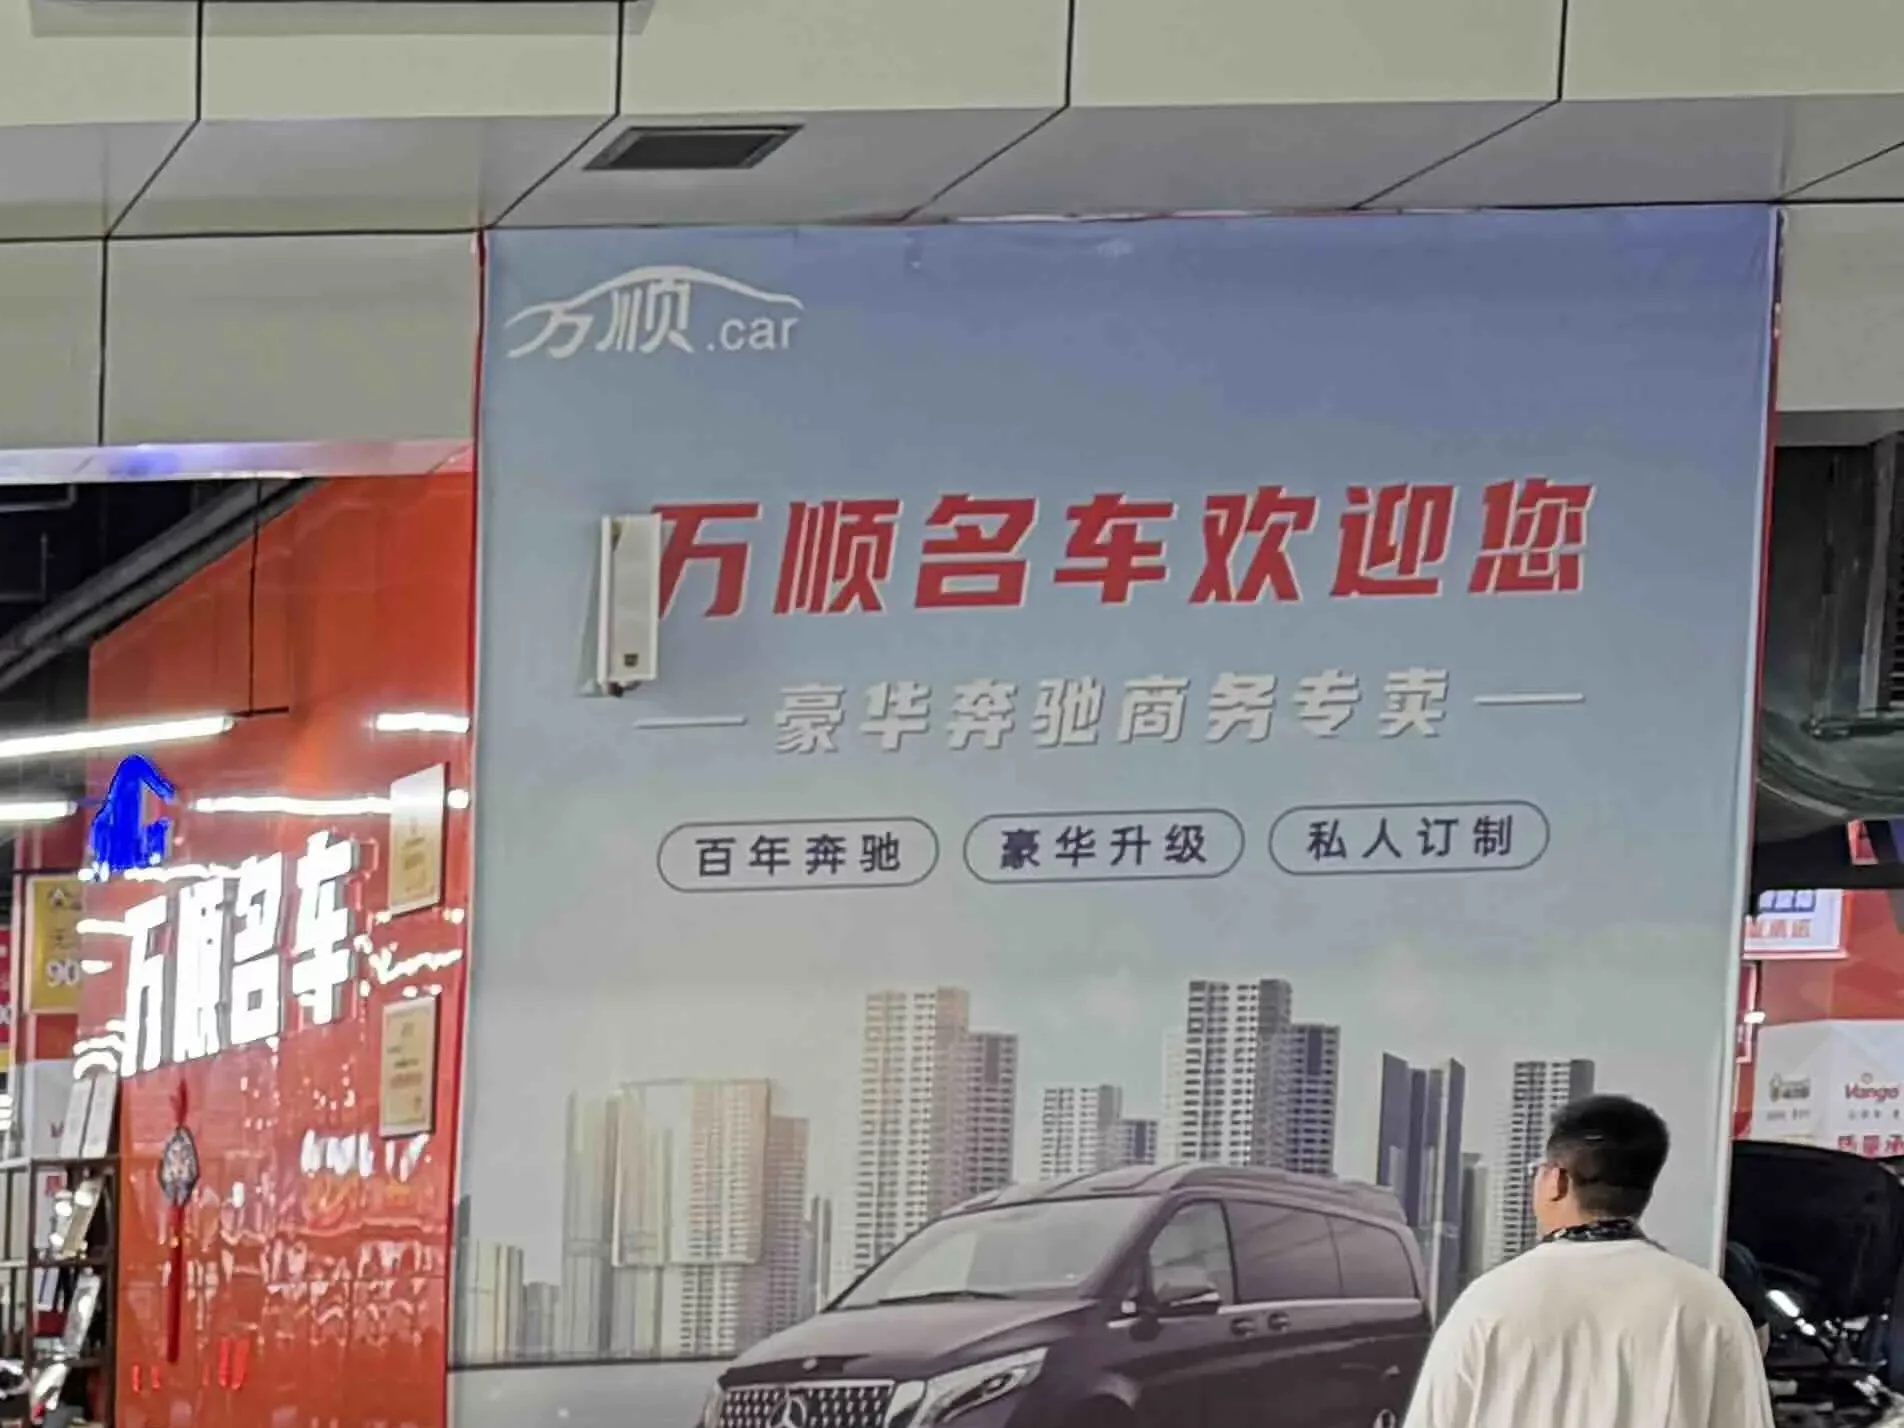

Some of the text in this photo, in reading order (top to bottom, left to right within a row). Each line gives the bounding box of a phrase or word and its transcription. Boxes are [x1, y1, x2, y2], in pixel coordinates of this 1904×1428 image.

[652, 476, 1595, 619] 万顺名车欢迎您
[774, 668, 1450, 755] 豪华奔驰商务专卖
[695, 831, 902, 877] 百年奔驰
[1000, 823, 1208, 870] 豪华升级
[1307, 815, 1515, 863] 私人订制
[120, 831, 352, 1077] 万顺名车
